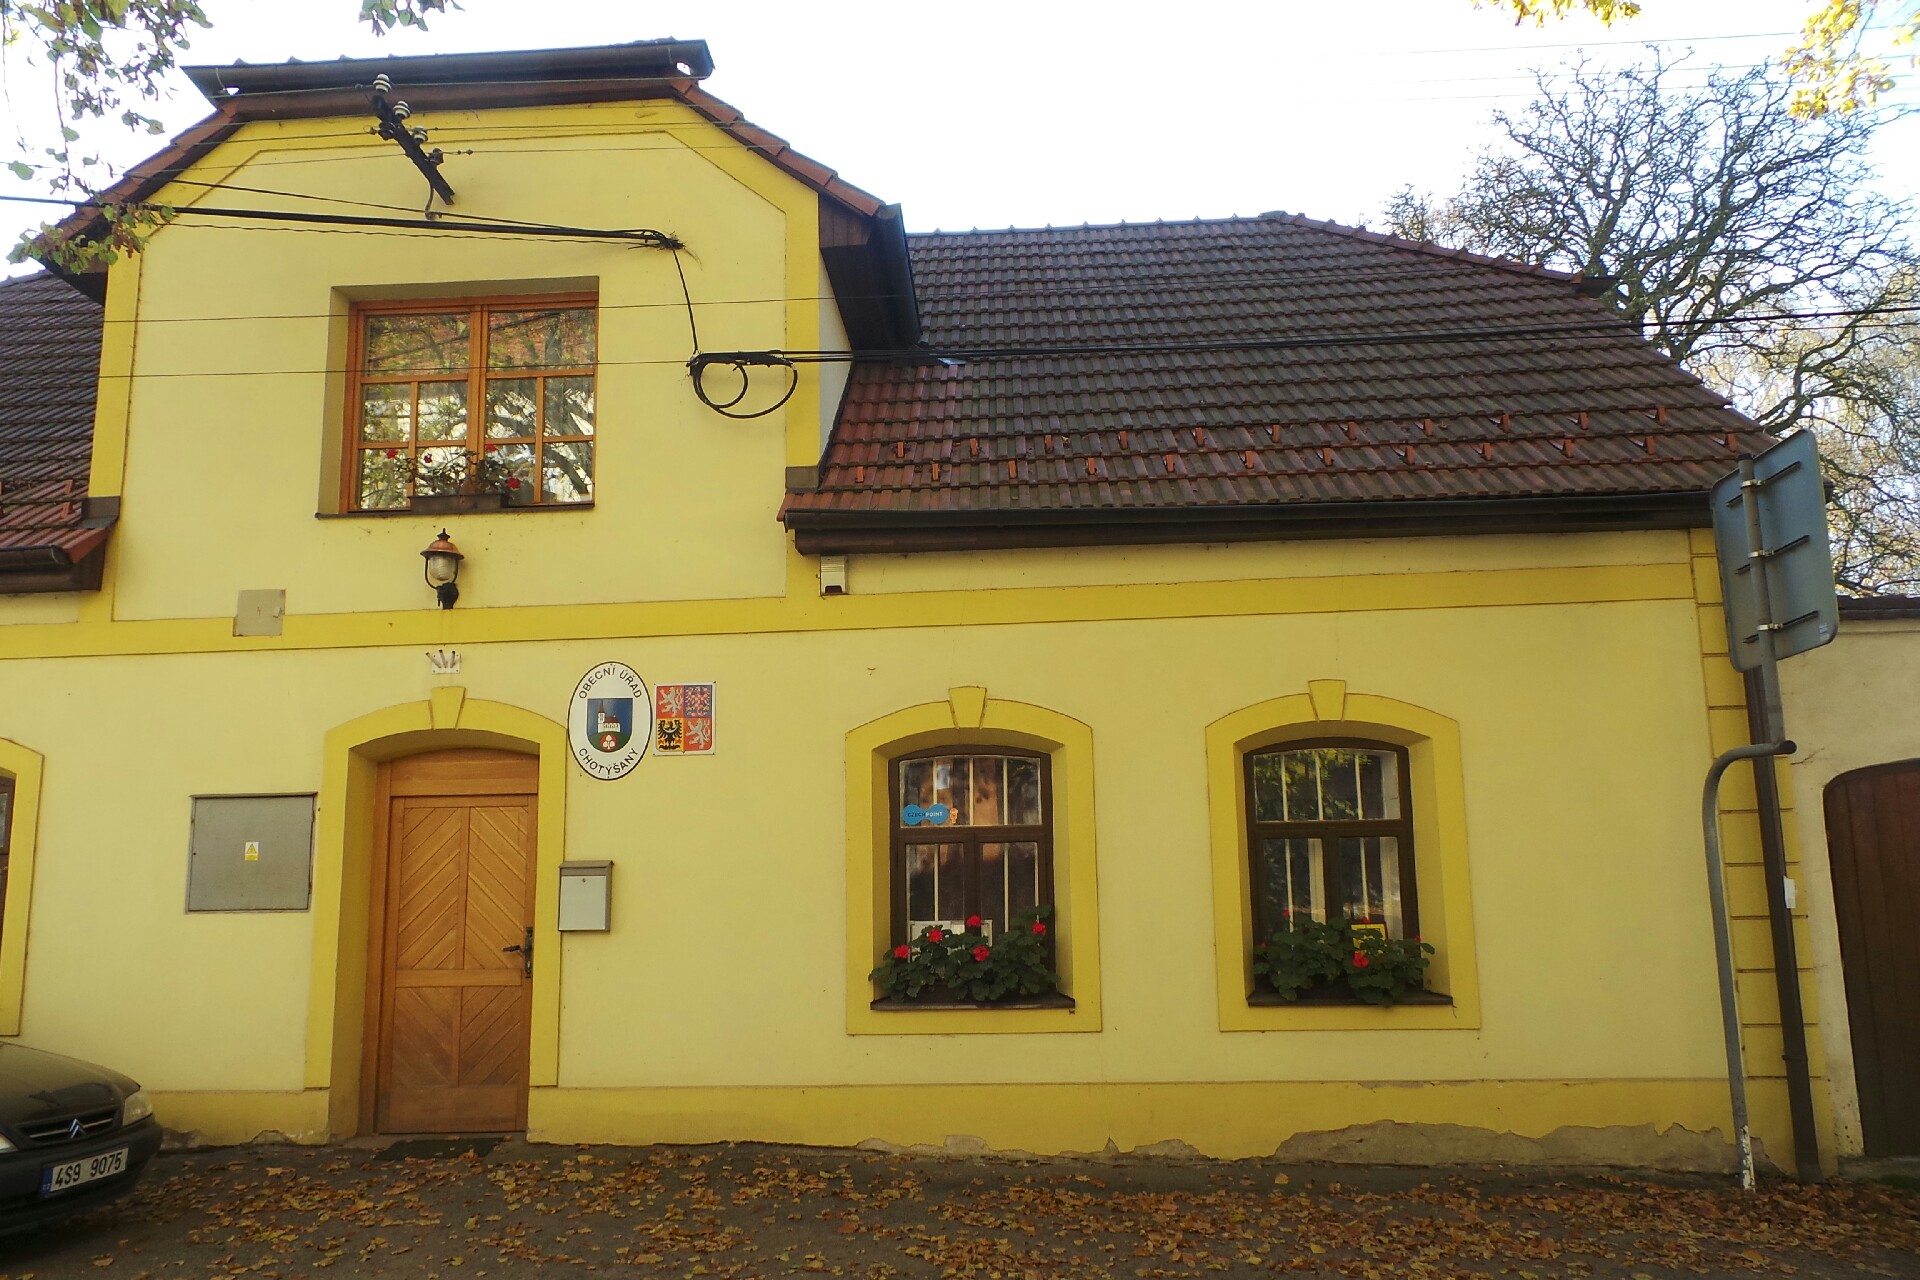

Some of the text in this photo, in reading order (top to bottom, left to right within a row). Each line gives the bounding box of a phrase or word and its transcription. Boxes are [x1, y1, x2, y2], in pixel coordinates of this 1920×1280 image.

[578, 664, 643, 700] OBECNÍ ÚŘAD
[578, 747, 639, 775] CHOTÝŠANY
[55, 1152, 123, 1187] 4S9 9075
